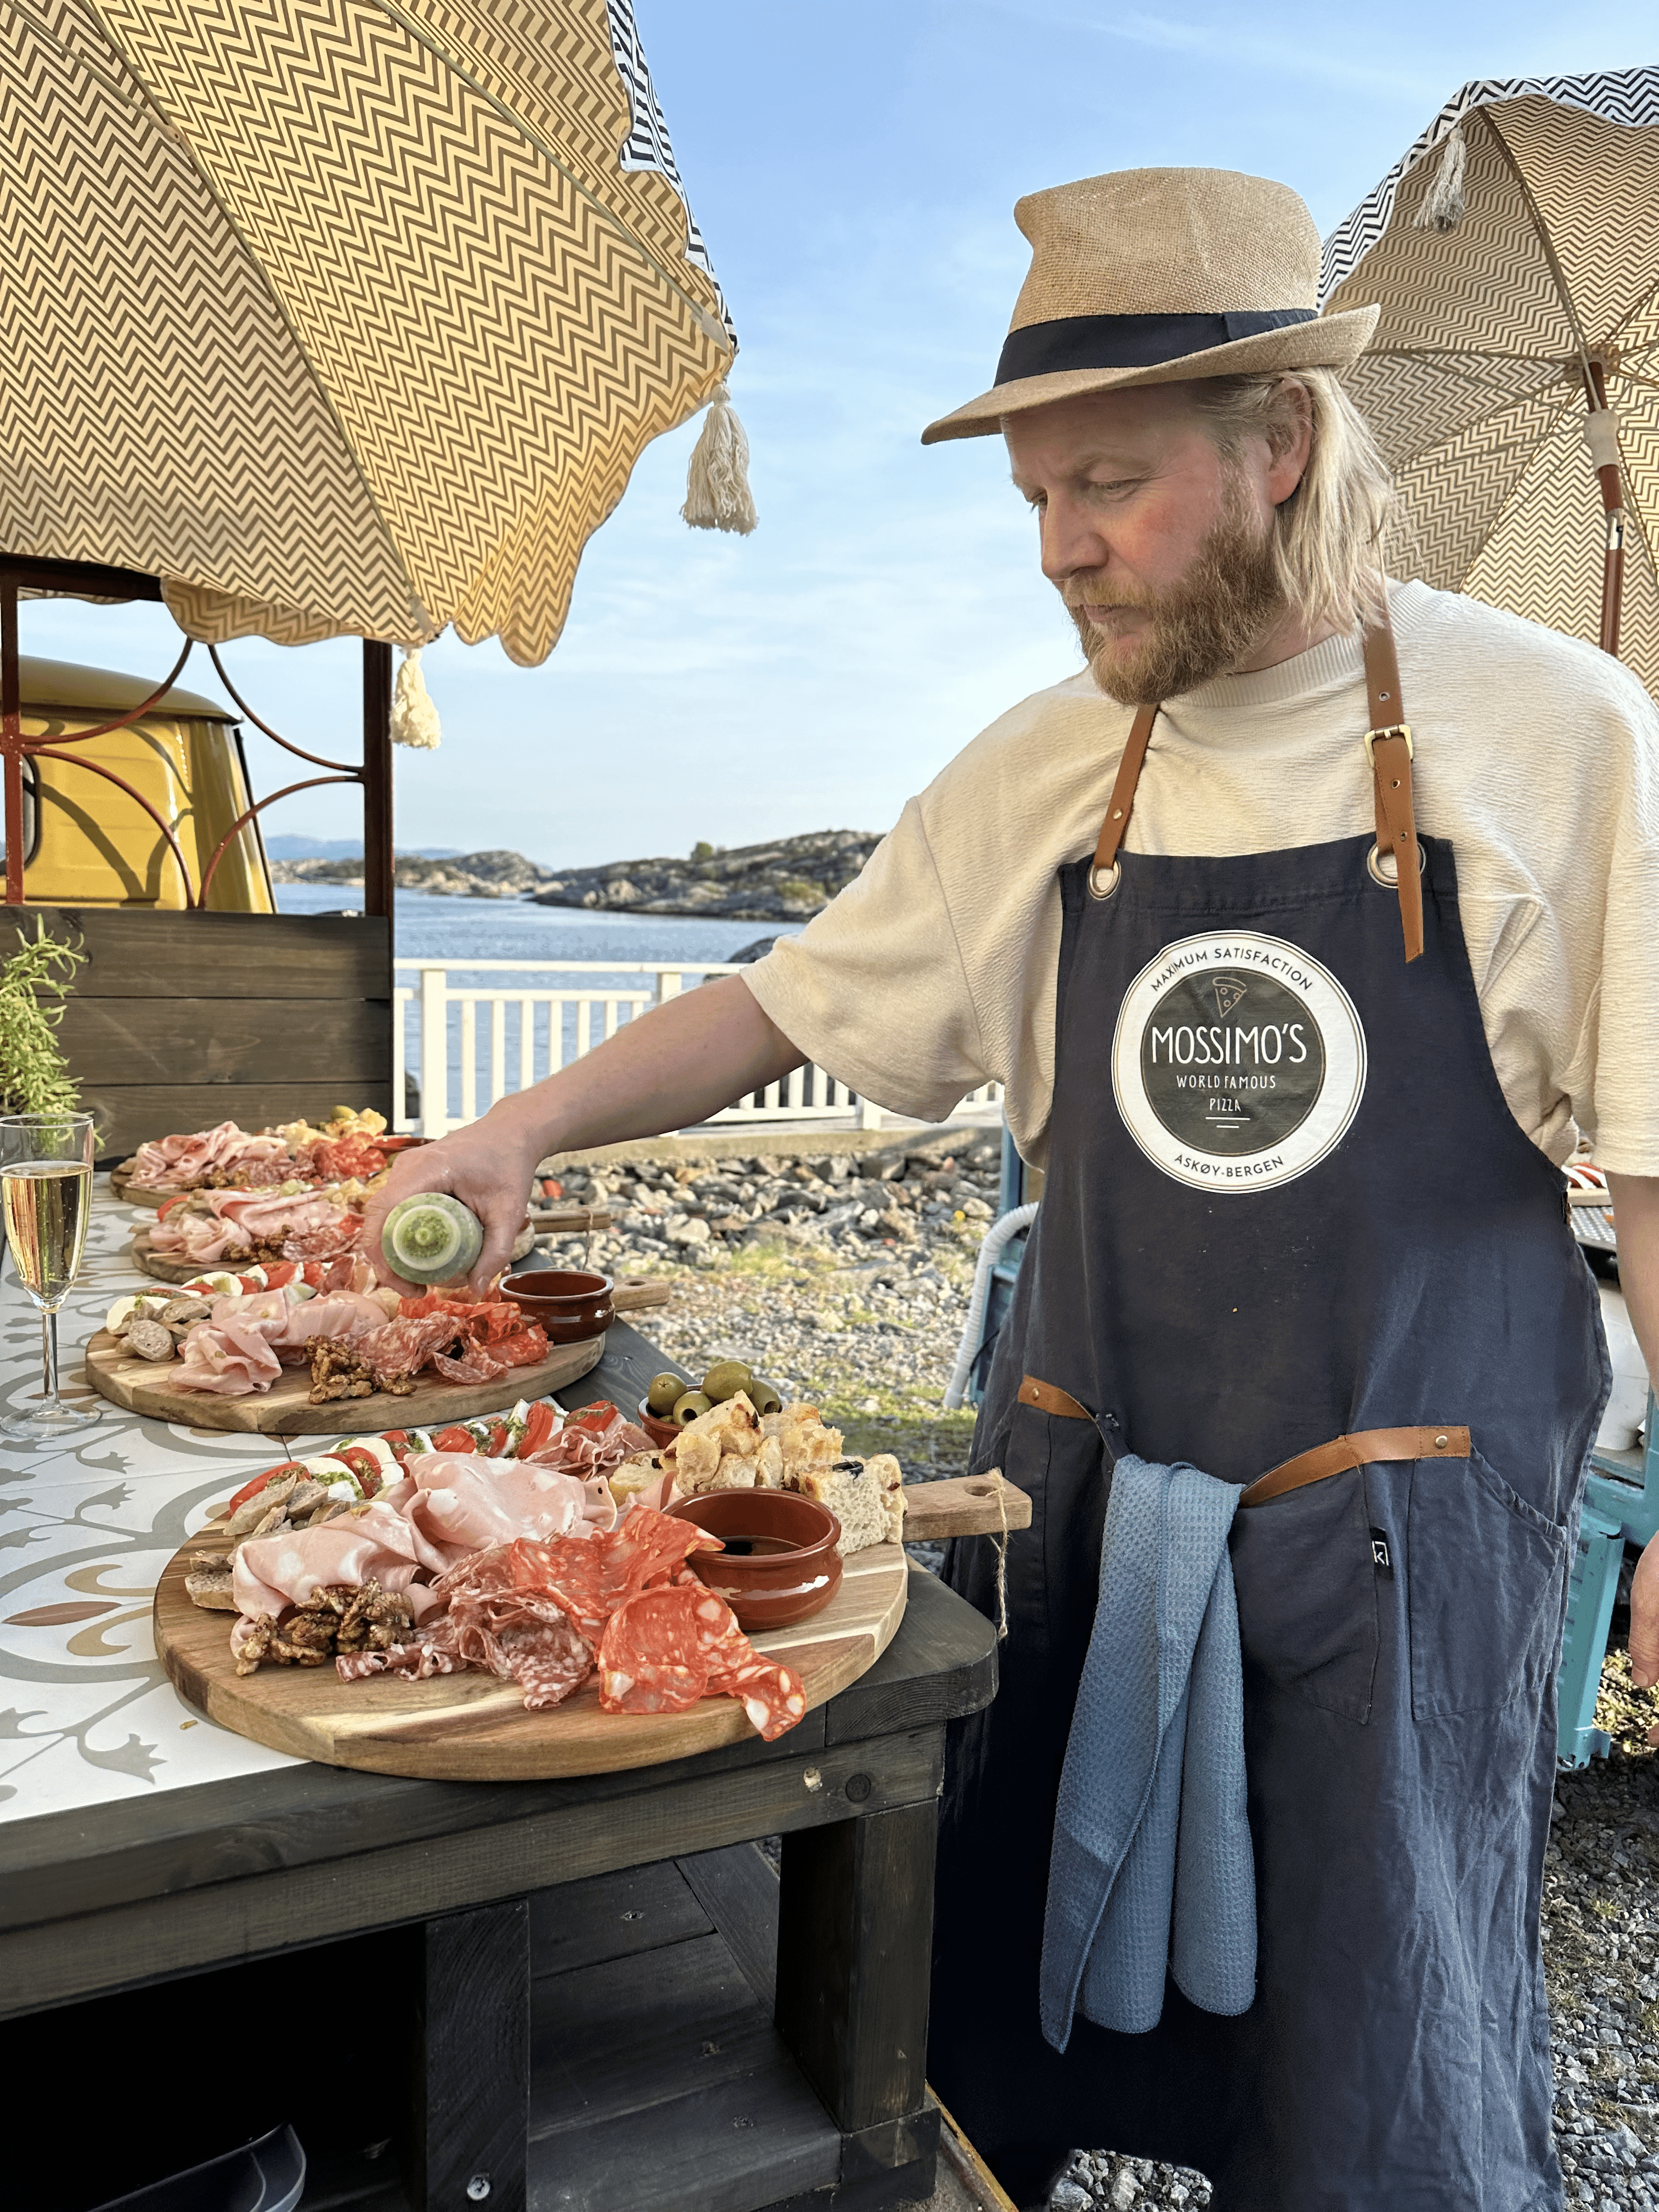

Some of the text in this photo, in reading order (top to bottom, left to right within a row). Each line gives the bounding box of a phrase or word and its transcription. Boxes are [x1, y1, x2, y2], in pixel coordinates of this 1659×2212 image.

[1151, 947, 1313, 992] MAXIMUM SATISFACTION
[1152, 1024, 1307, 1064] MOSSIMO'S
[1176, 1075, 1276, 1089] WORLD FAMOUS
[1209, 1098, 1242, 1113] PIZZA
[1175, 1154, 1284, 1177] ASKØY-BERGEN
